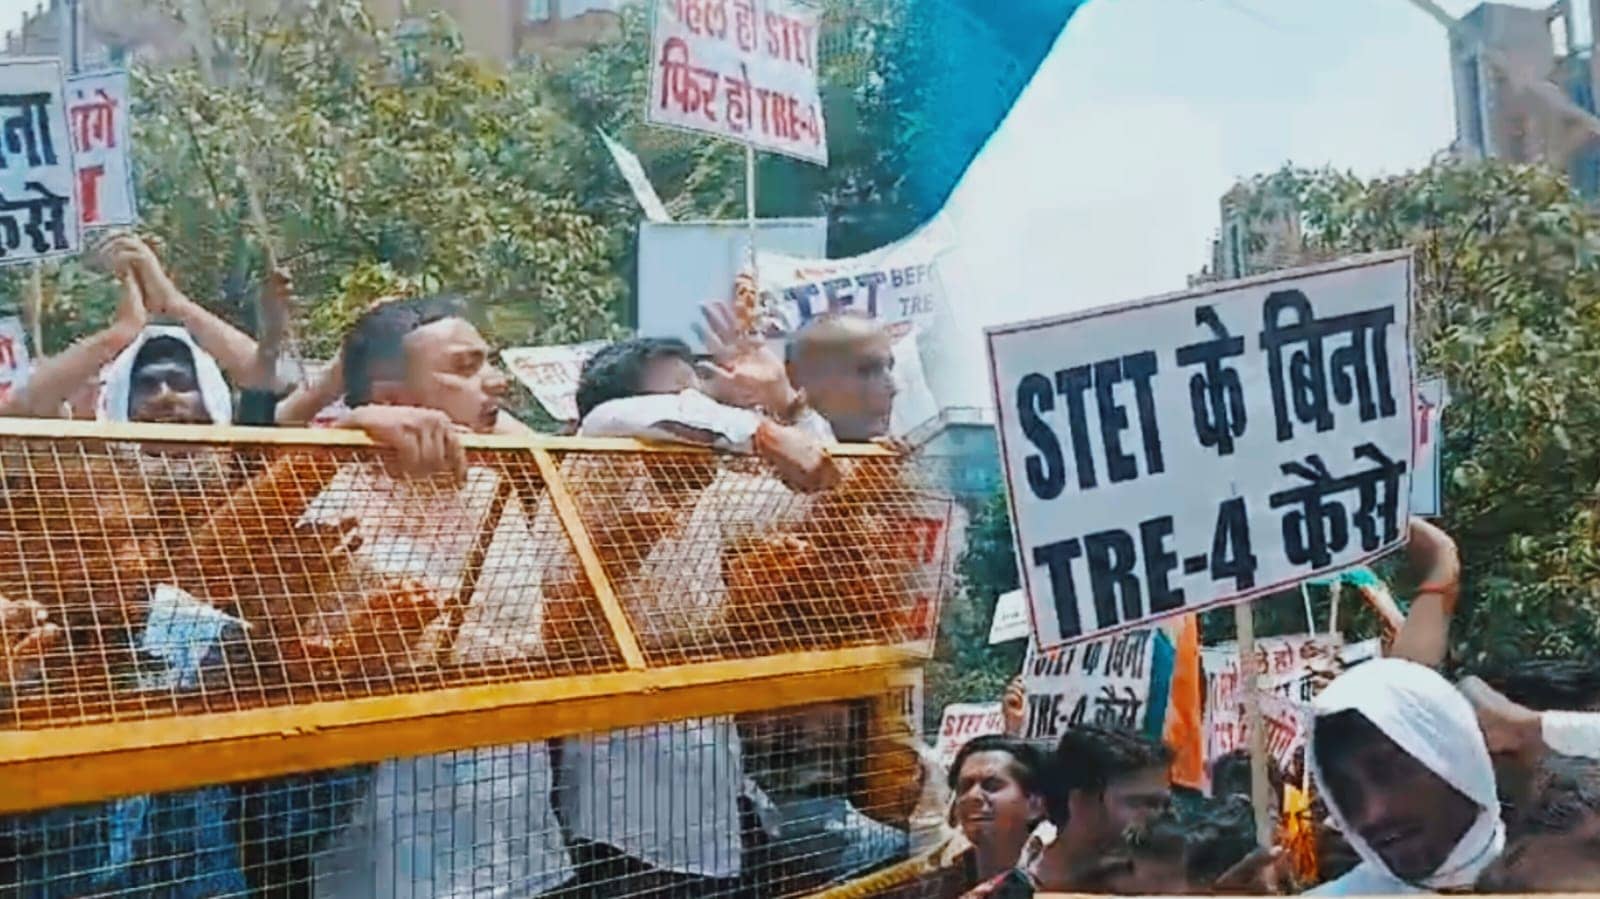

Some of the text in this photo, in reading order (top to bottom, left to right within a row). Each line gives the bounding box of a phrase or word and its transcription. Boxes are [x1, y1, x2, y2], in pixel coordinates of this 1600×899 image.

[0, 92, 57, 169] ना
[660, 36, 820, 145] फिर हो TRE-4
[1016, 288, 1396, 500] STET के बिना
[1032, 443, 1407, 640] TRE-4 कैसे
